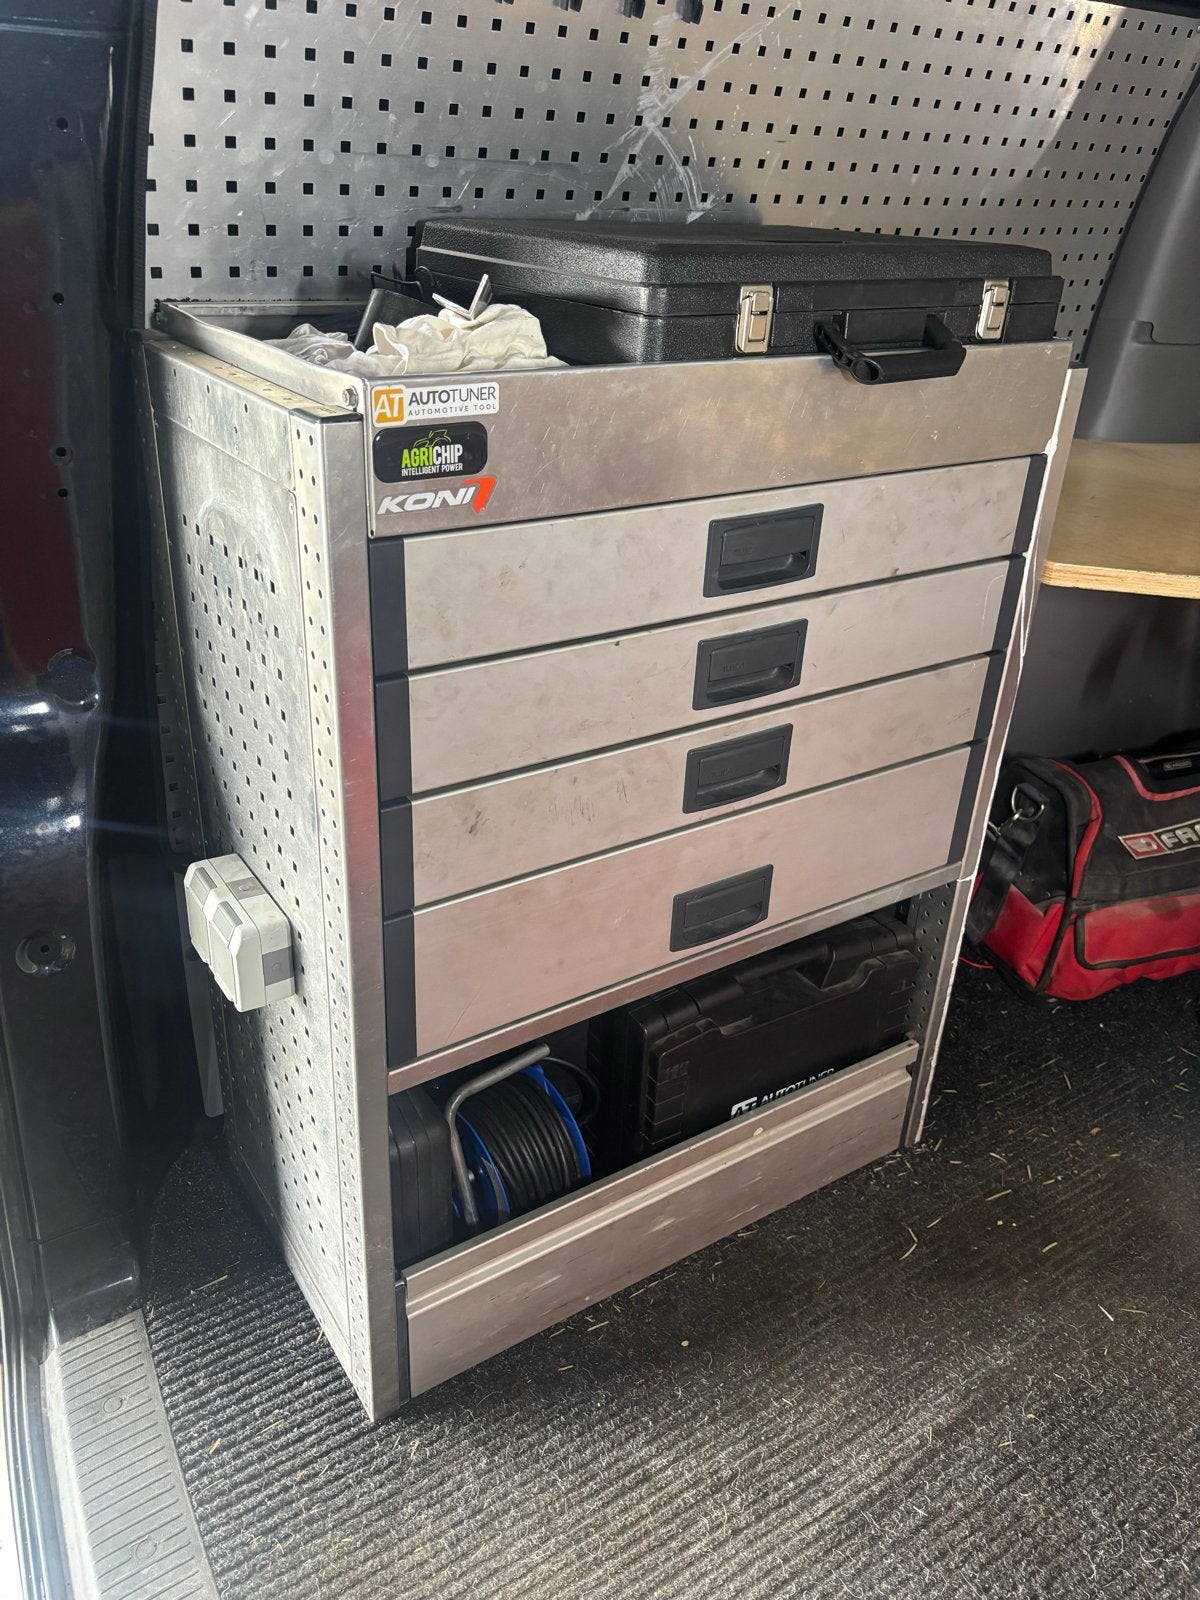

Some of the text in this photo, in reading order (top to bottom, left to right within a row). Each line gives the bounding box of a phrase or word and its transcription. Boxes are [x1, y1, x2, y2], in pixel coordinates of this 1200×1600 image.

[375, 392, 404, 419] AT
[408, 386, 496, 406] AUTOTUNER
[408, 403, 496, 416] AUTOMOTIVE TOOL
[401, 444, 463, 468] AGRICHIP
[401, 463, 463, 476] INTELLIGENT POWER
[1160, 823, 1200, 848] FA
